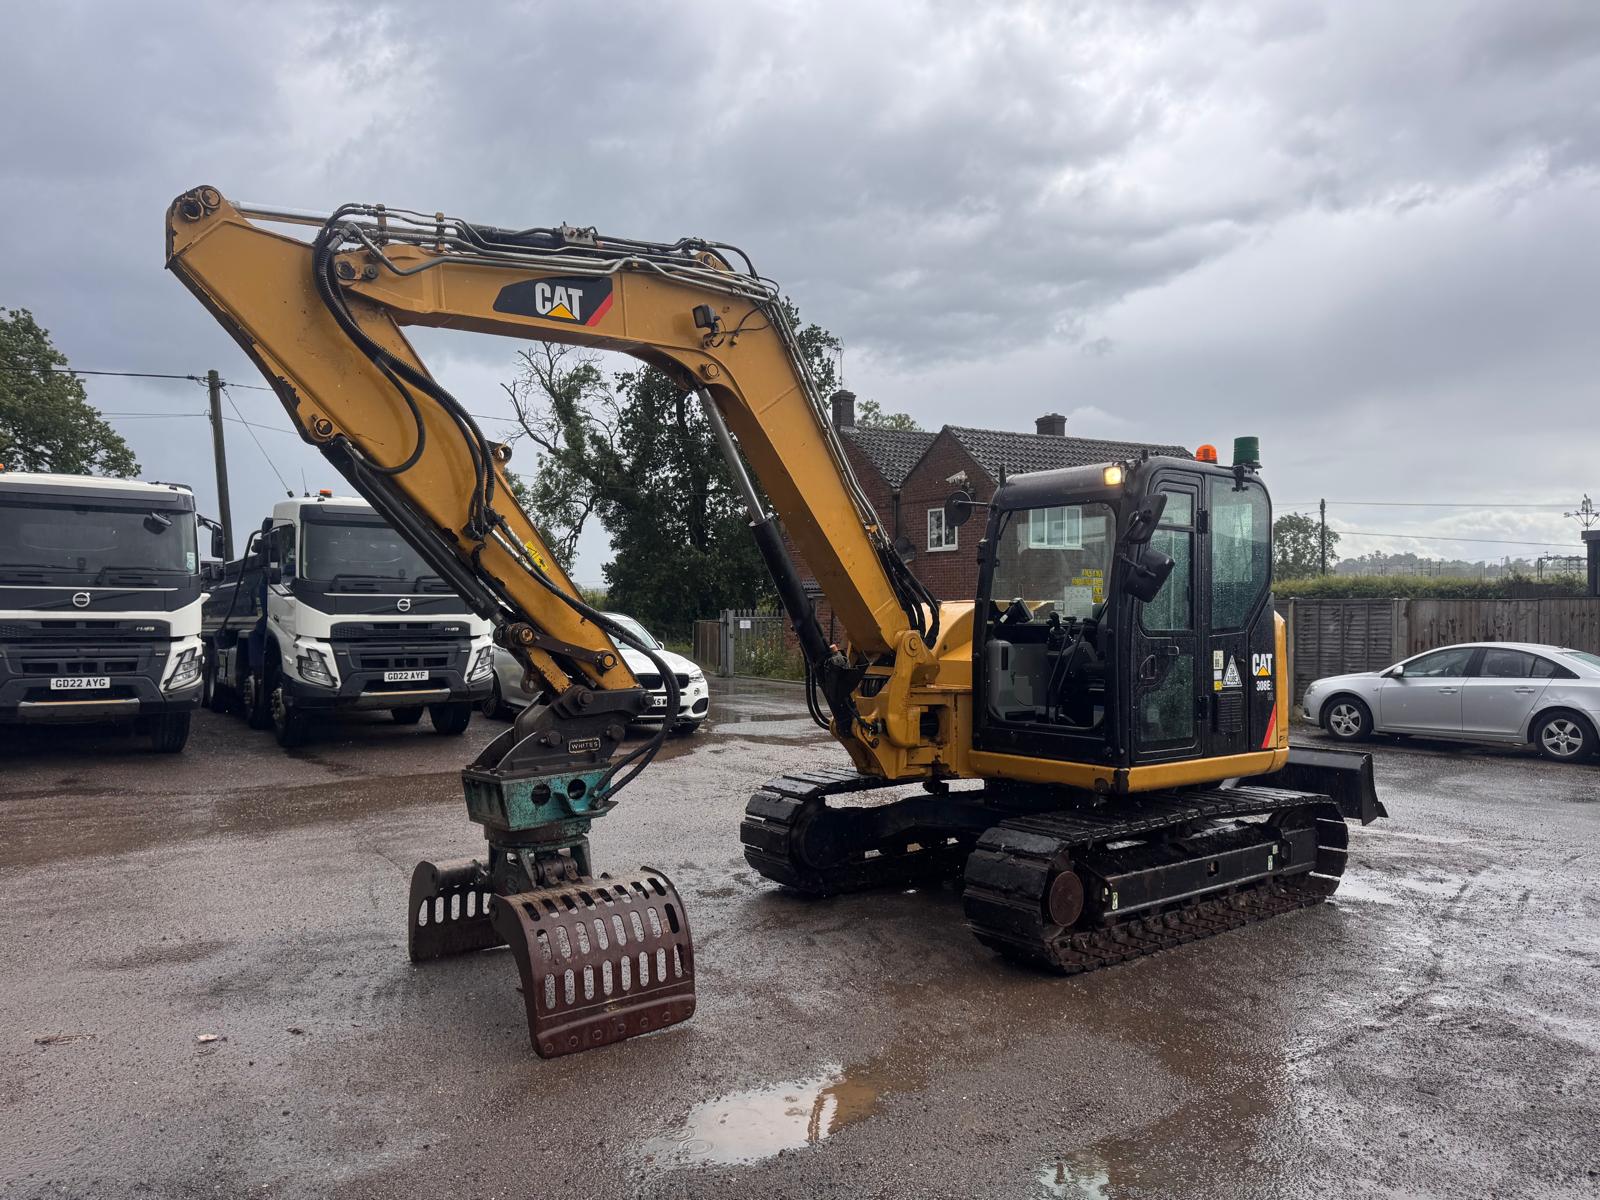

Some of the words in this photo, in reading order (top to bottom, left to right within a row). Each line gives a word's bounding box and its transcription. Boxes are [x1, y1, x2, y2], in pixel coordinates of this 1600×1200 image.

[535, 282, 583, 320] CAT
[1252, 653, 1272, 676] CAT
[55, 679, 83, 687] GD22
[86, 678, 106, 687] AYG
[387, 672, 409, 680] GD22
[410, 671, 426, 680] AYF
